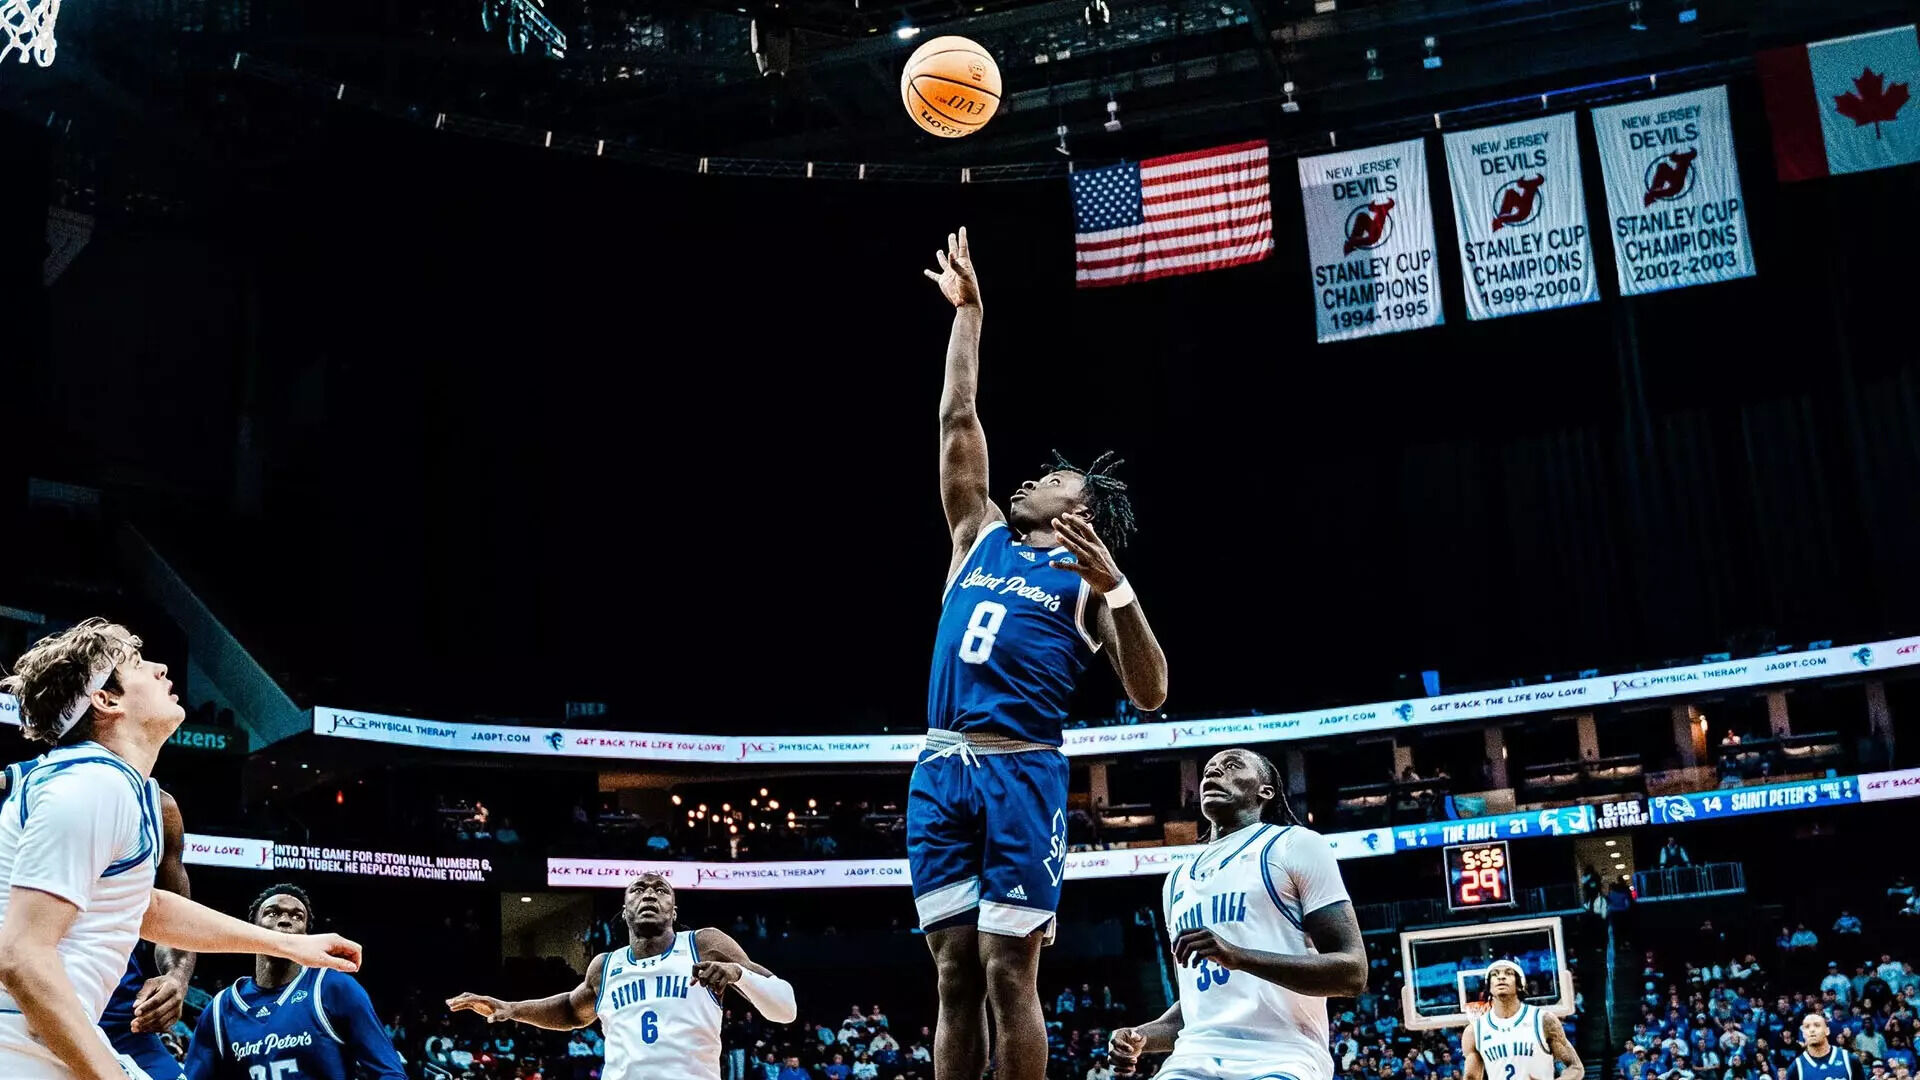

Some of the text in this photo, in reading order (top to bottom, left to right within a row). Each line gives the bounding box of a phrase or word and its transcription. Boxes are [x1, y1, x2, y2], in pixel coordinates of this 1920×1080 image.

[1622, 105, 1701, 130] NEW JERSEY
[1472, 132, 1549, 156] NEW JERSEY
[1630, 123, 1698, 150] DEVILS
[1326, 158, 1401, 180] NEW JERSEY
[1480, 149, 1547, 176] DEVILS
[1333, 175, 1398, 201] DEVILS
[1616, 199, 1739, 238] STANLEY CUP
[1464, 225, 1585, 263] STANLEY CUP
[1625, 225, 1737, 263] CHAMPIONS
[1315, 250, 1432, 287] STANLEY CUP
[1473, 250, 1582, 287] CHAMPIONS
[1634, 252, 1737, 282] 2002-2003
[1323, 274, 1429, 310] CHAMPIONS
[1480, 277, 1581, 307] 1999-2000
[1331, 300, 1428, 330] 1994-1995
[959, 566, 1061, 612] Saint Peter's
[958, 600, 1008, 665] 8
[1896, 643, 1919, 656] GET
[1649, 673, 1699, 686] PHYSICAL
[1702, 666, 1748, 680] THERAPY
[1764, 657, 1827, 672] JAGPT.COM
[1430, 686, 1587, 712] GET BACK THE LIFE YOU LOVE!
[327, 714, 457, 739] JAG PHYSICAL THERAPY
[1208, 724, 1254, 734] PHYSICAL
[1257, 719, 1300, 731] THERAPY
[1318, 712, 1377, 726] JAGPT.COM
[471, 731, 531, 743] JAGPT.COM
[575, 737, 596, 746] GET
[600, 738, 625, 748] BACK
[628, 740, 648, 749] THE
[651, 741, 673, 750] LIFE
[677, 742, 695, 751] YOU
[778, 743, 825, 752] PHYSICAL
[827, 743, 870, 752] THERAPY
[1867, 780, 1889, 790] GET
[1602, 800, 1641, 818] 5:55
[1702, 784, 1818, 813] 14 SAINT PETER'S
[1442, 818, 1529, 844] THE HALL 21
[1597, 812, 1650, 829] 1ST HALF
[192, 843, 211, 853] YOU
[274, 844, 299, 858] INTO
[300, 846, 321, 859] THE
[322, 848, 352, 862] GAME
[352, 850, 374, 863] FOR
[374, 852, 407, 866] SETON
[436, 856, 480, 870] NUMBER
[481, 859, 493, 872] 6,
[1462, 848, 1504, 870] 5:55
[274, 856, 307, 871] DAVID
[307, 859, 343, 873] TUBEK.
[344, 862, 359, 874] HE
[360, 862, 411, 878] REPLACES
[411, 866, 447, 881] YACINE
[448, 868, 486, 882] TOUMI.
[550, 866, 571, 875] ACK
[574, 867, 593, 876] THE
[597, 867, 620, 877] LIFE
[732, 869, 779, 878] PHYSICAL
[782, 868, 826, 877] THERAPY
[843, 867, 903, 877] JAGPT.COM
[1461, 868, 1501, 902] 29
[1212, 892, 1247, 924] HALL
[611, 975, 689, 1010] SETON HALL
[641, 1010, 659, 1045] 6
[232, 1031, 312, 1062] Saint Peter's
[1505, 1063, 1516, 1080] 2
